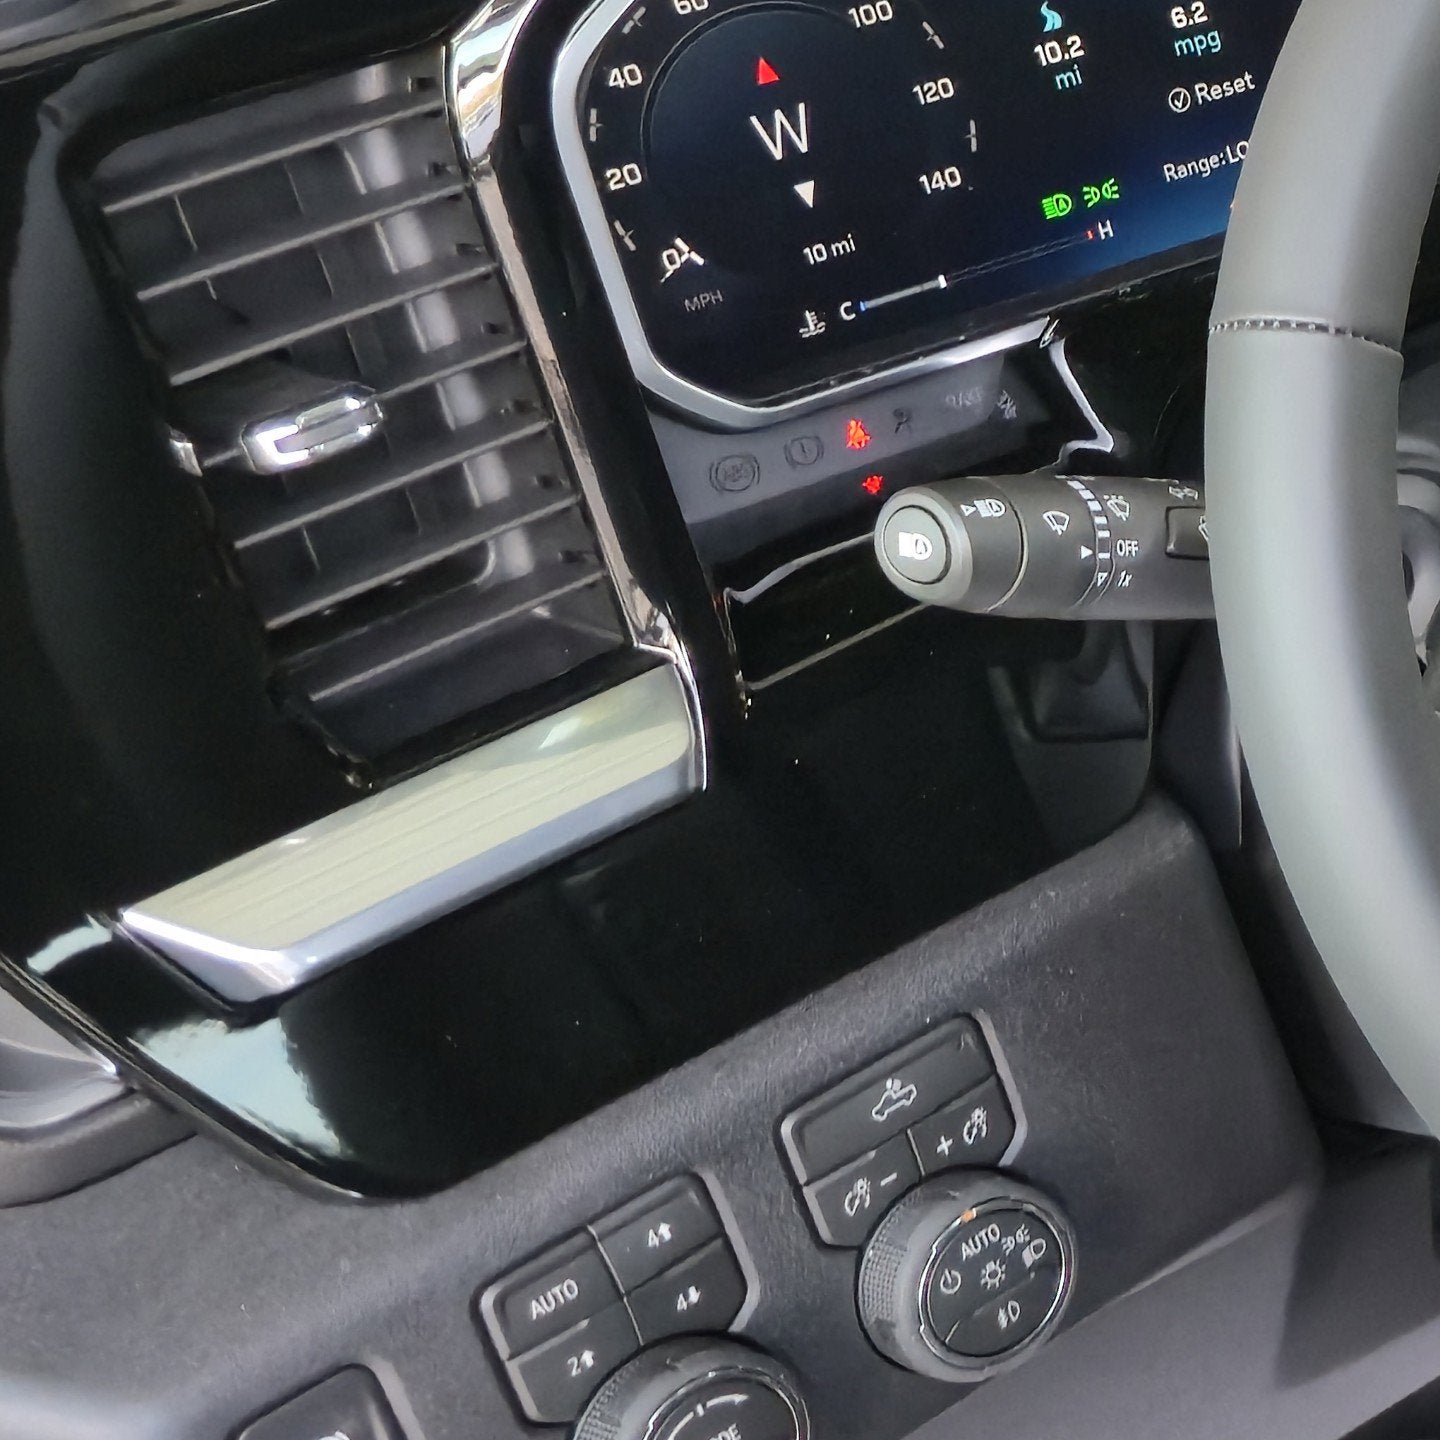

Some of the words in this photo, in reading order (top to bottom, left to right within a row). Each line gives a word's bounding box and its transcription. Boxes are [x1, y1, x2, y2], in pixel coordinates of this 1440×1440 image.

[1169, 0, 1209, 30] 6.2
[1033, 36, 1086, 67] 10.2
[1173, 27, 1223, 59] mpg
[607, 64, 644, 90] 40
[912, 77, 955, 106] 120
[1053, 65, 1084, 92] mi
[1194, 70, 1257, 104] Reset
[749, 102, 810, 160] W
[606, 163, 643, 190] 20
[919, 166, 964, 196] 140
[1162, 151, 1227, 183] Range:
[1098, 221, 1114, 241] H
[803, 241, 828, 265] 10
[830, 233, 857, 257] mi
[683, 288, 724, 313] MPH
[839, 301, 855, 322] C
[1116, 538, 1139, 558] OFF
[1116, 569, 1134, 589] 1x
[958, 1222, 1003, 1263] AUTO
[529, 1277, 582, 1322] AUTO
